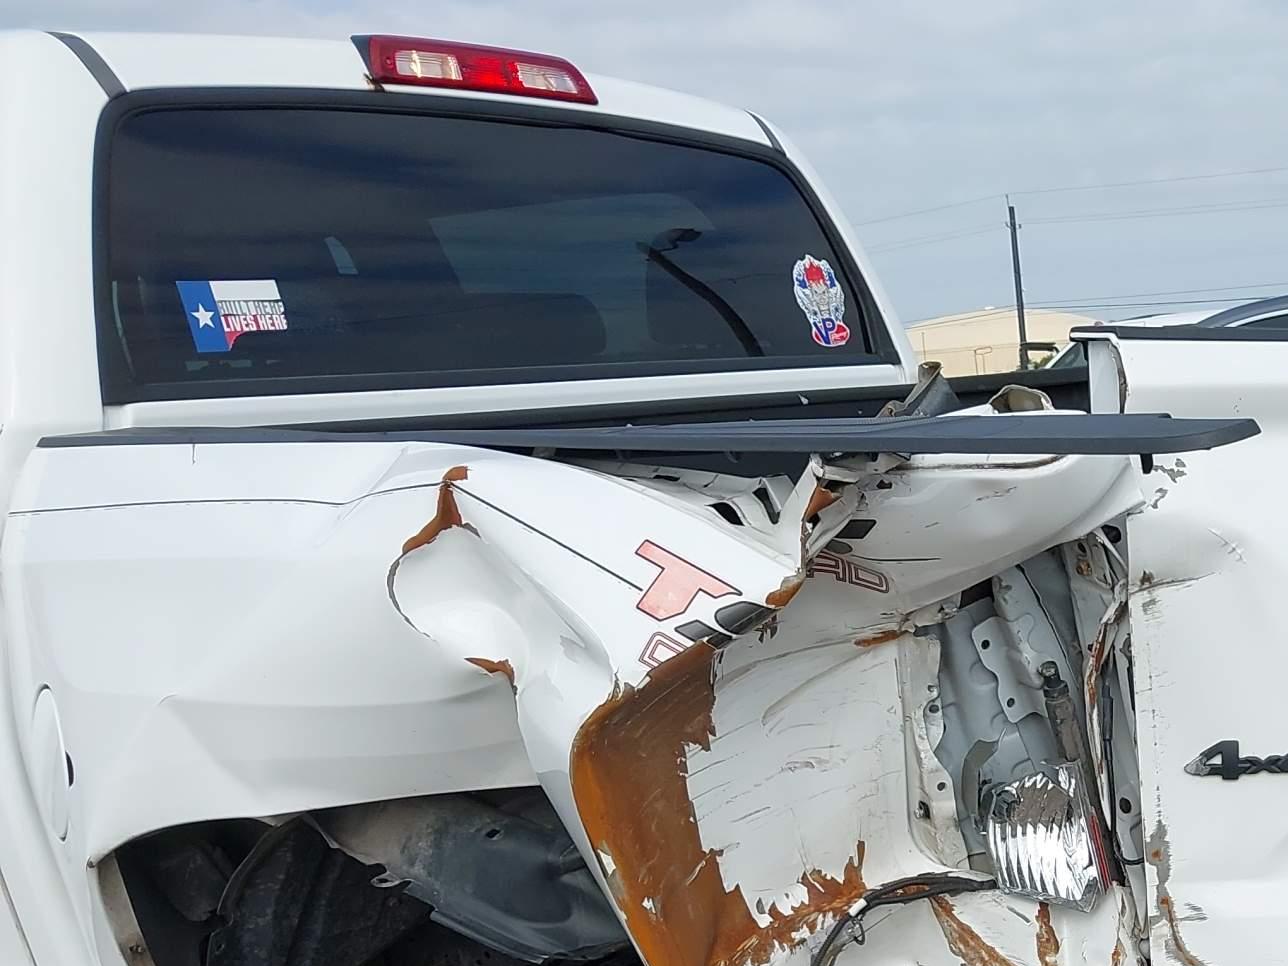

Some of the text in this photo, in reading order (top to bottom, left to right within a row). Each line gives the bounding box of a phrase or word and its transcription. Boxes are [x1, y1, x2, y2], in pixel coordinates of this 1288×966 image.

[220, 313, 288, 332] LIVES HERE
[813, 317, 836, 345] VP
